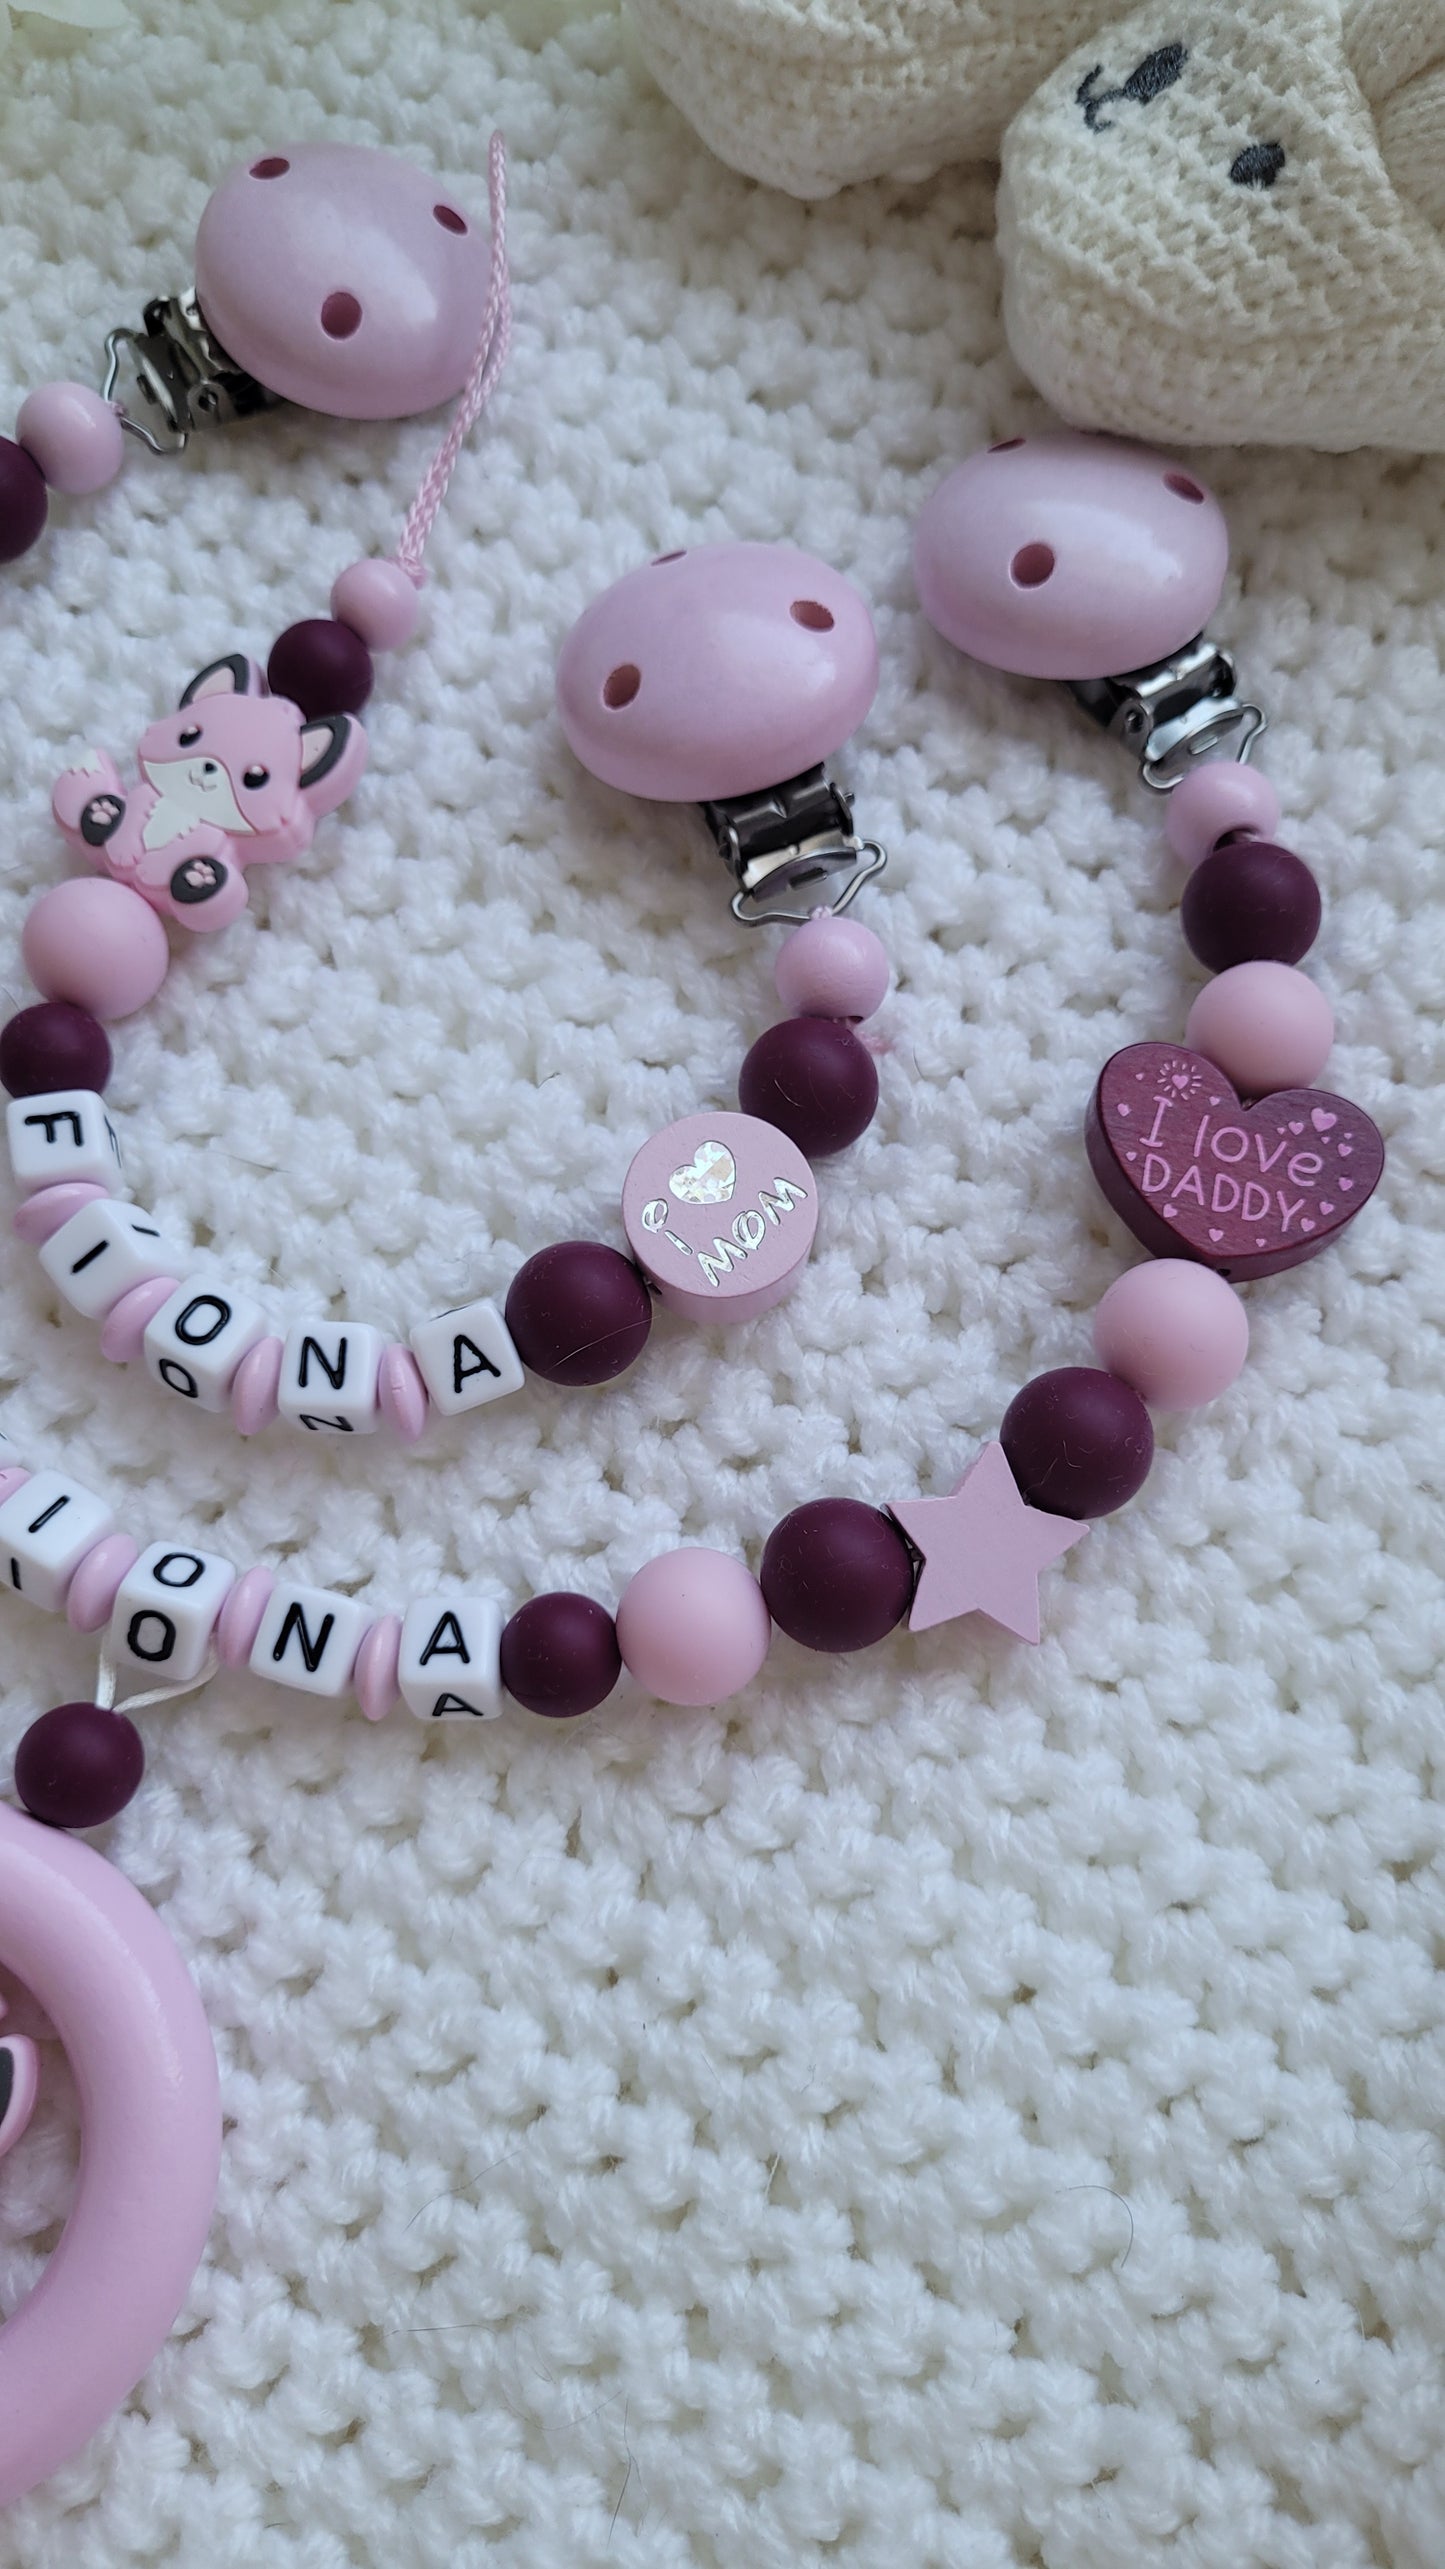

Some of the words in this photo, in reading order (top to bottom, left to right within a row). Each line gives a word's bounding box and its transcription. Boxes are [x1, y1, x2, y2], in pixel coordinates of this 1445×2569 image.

[1139, 1095, 1173, 1148] I
[1193, 1114, 1323, 1187] love
[697, 1176, 809, 1288] MOM
[1141, 1153, 1305, 1232] DADDY
